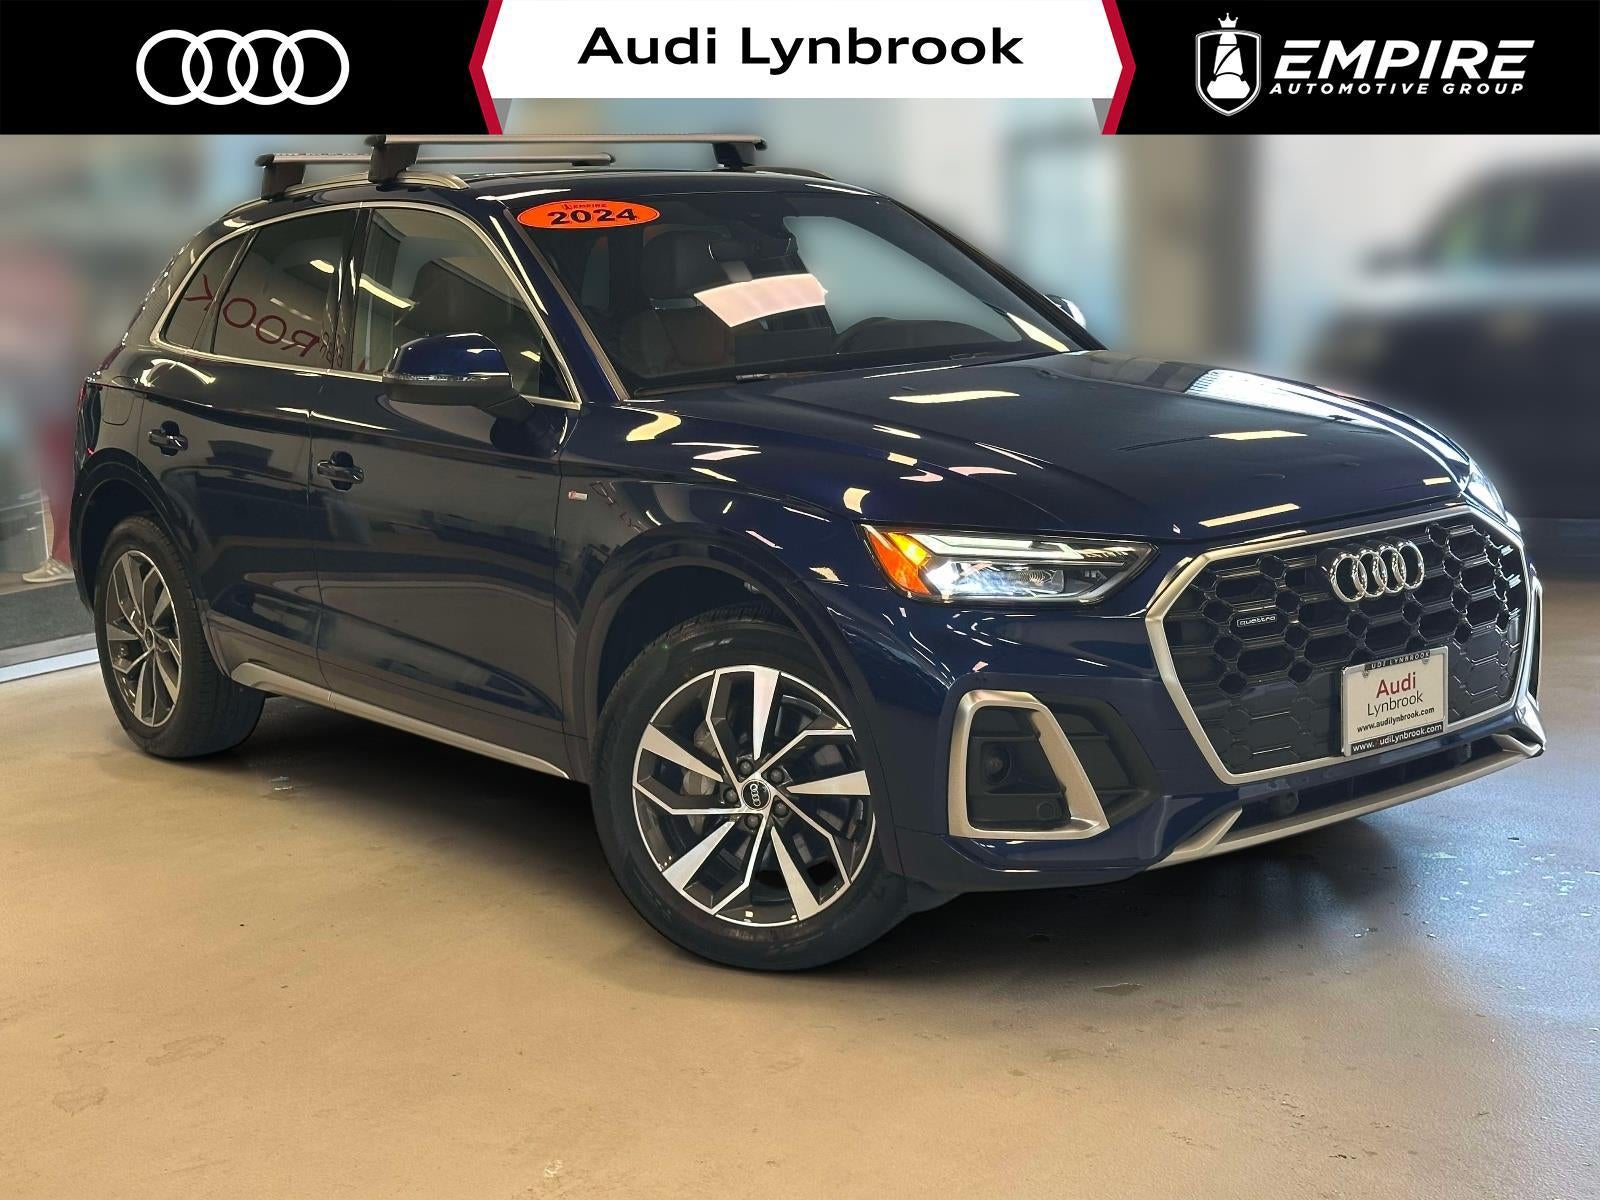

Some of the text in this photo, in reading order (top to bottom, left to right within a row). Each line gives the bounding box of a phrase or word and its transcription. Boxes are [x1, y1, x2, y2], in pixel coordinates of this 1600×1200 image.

[547, 208, 640, 226] 2024
[1239, 615, 1276, 627] quattro
[1389, 651, 1430, 666] LYNBROOK
[1376, 671, 1417, 699] Audi
[1367, 690, 1424, 718] Lynbrook
[1356, 706, 1436, 733] www.audilynbrook.com
[1352, 723, 1443, 753] www.udiLynbrook.com
